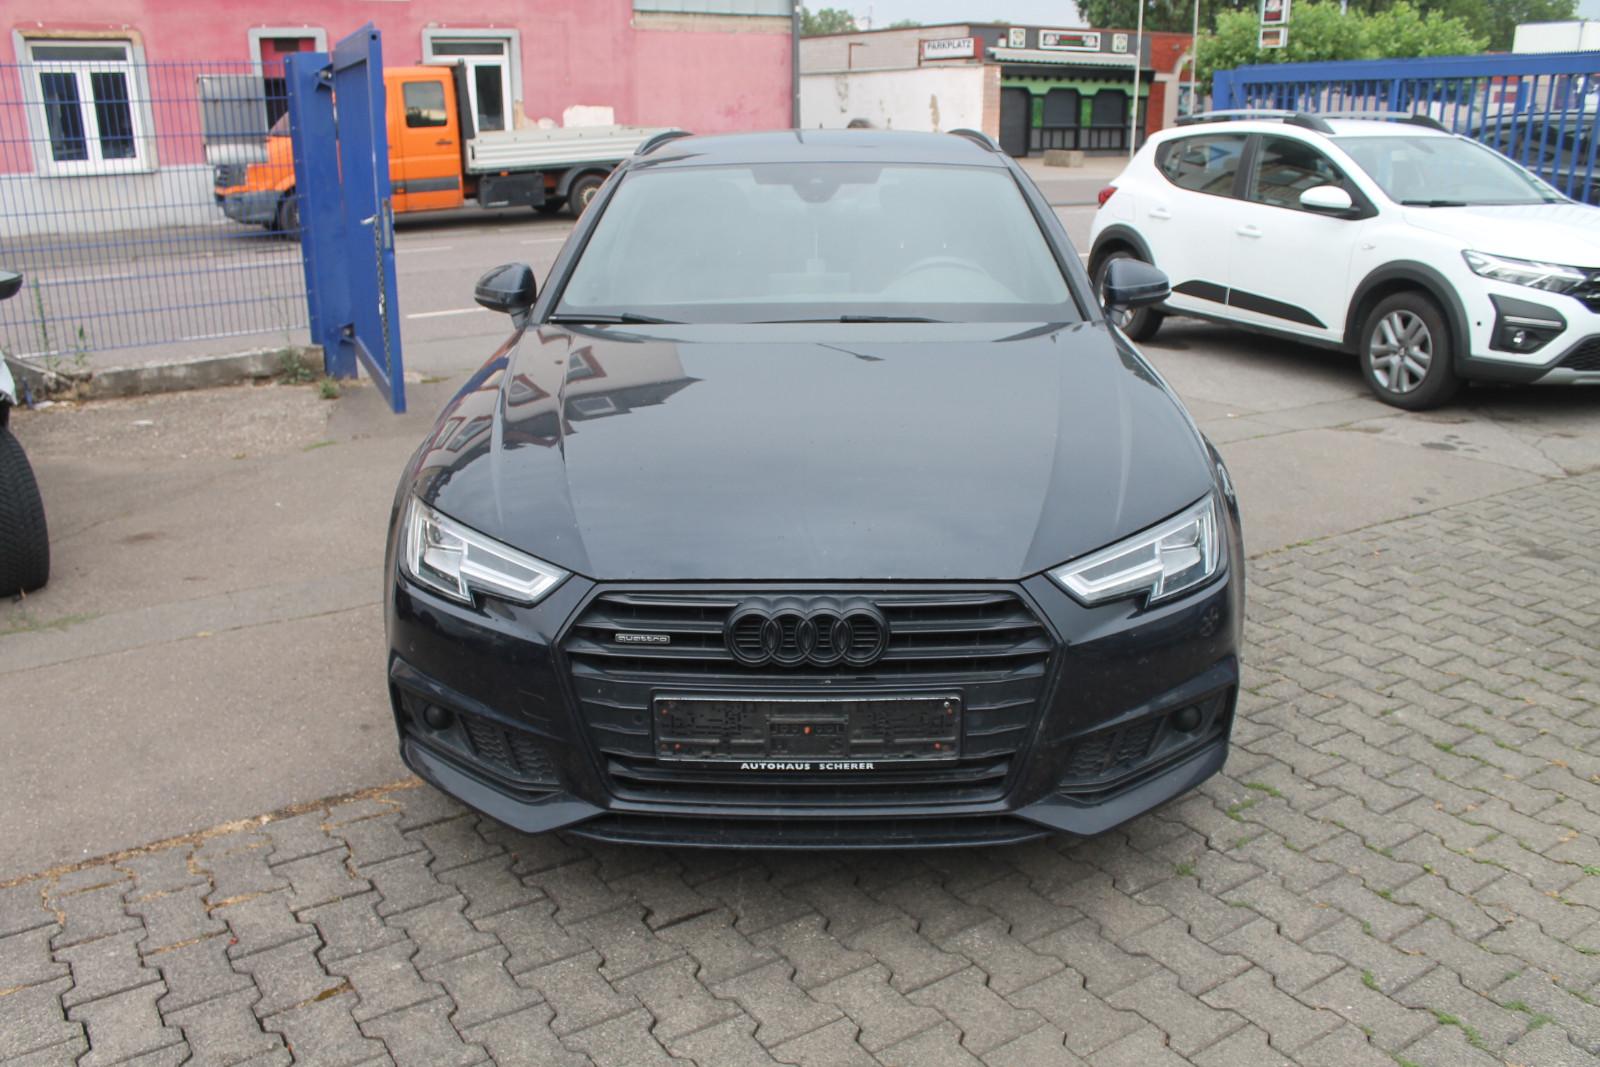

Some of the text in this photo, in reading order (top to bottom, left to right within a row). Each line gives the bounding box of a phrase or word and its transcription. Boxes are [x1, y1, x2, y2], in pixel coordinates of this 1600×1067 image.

[927, 39, 972, 49] PARKPLATZ
[616, 634, 668, 643] quattro
[740, 762, 875, 770] AUTOHAUS SCHERER
